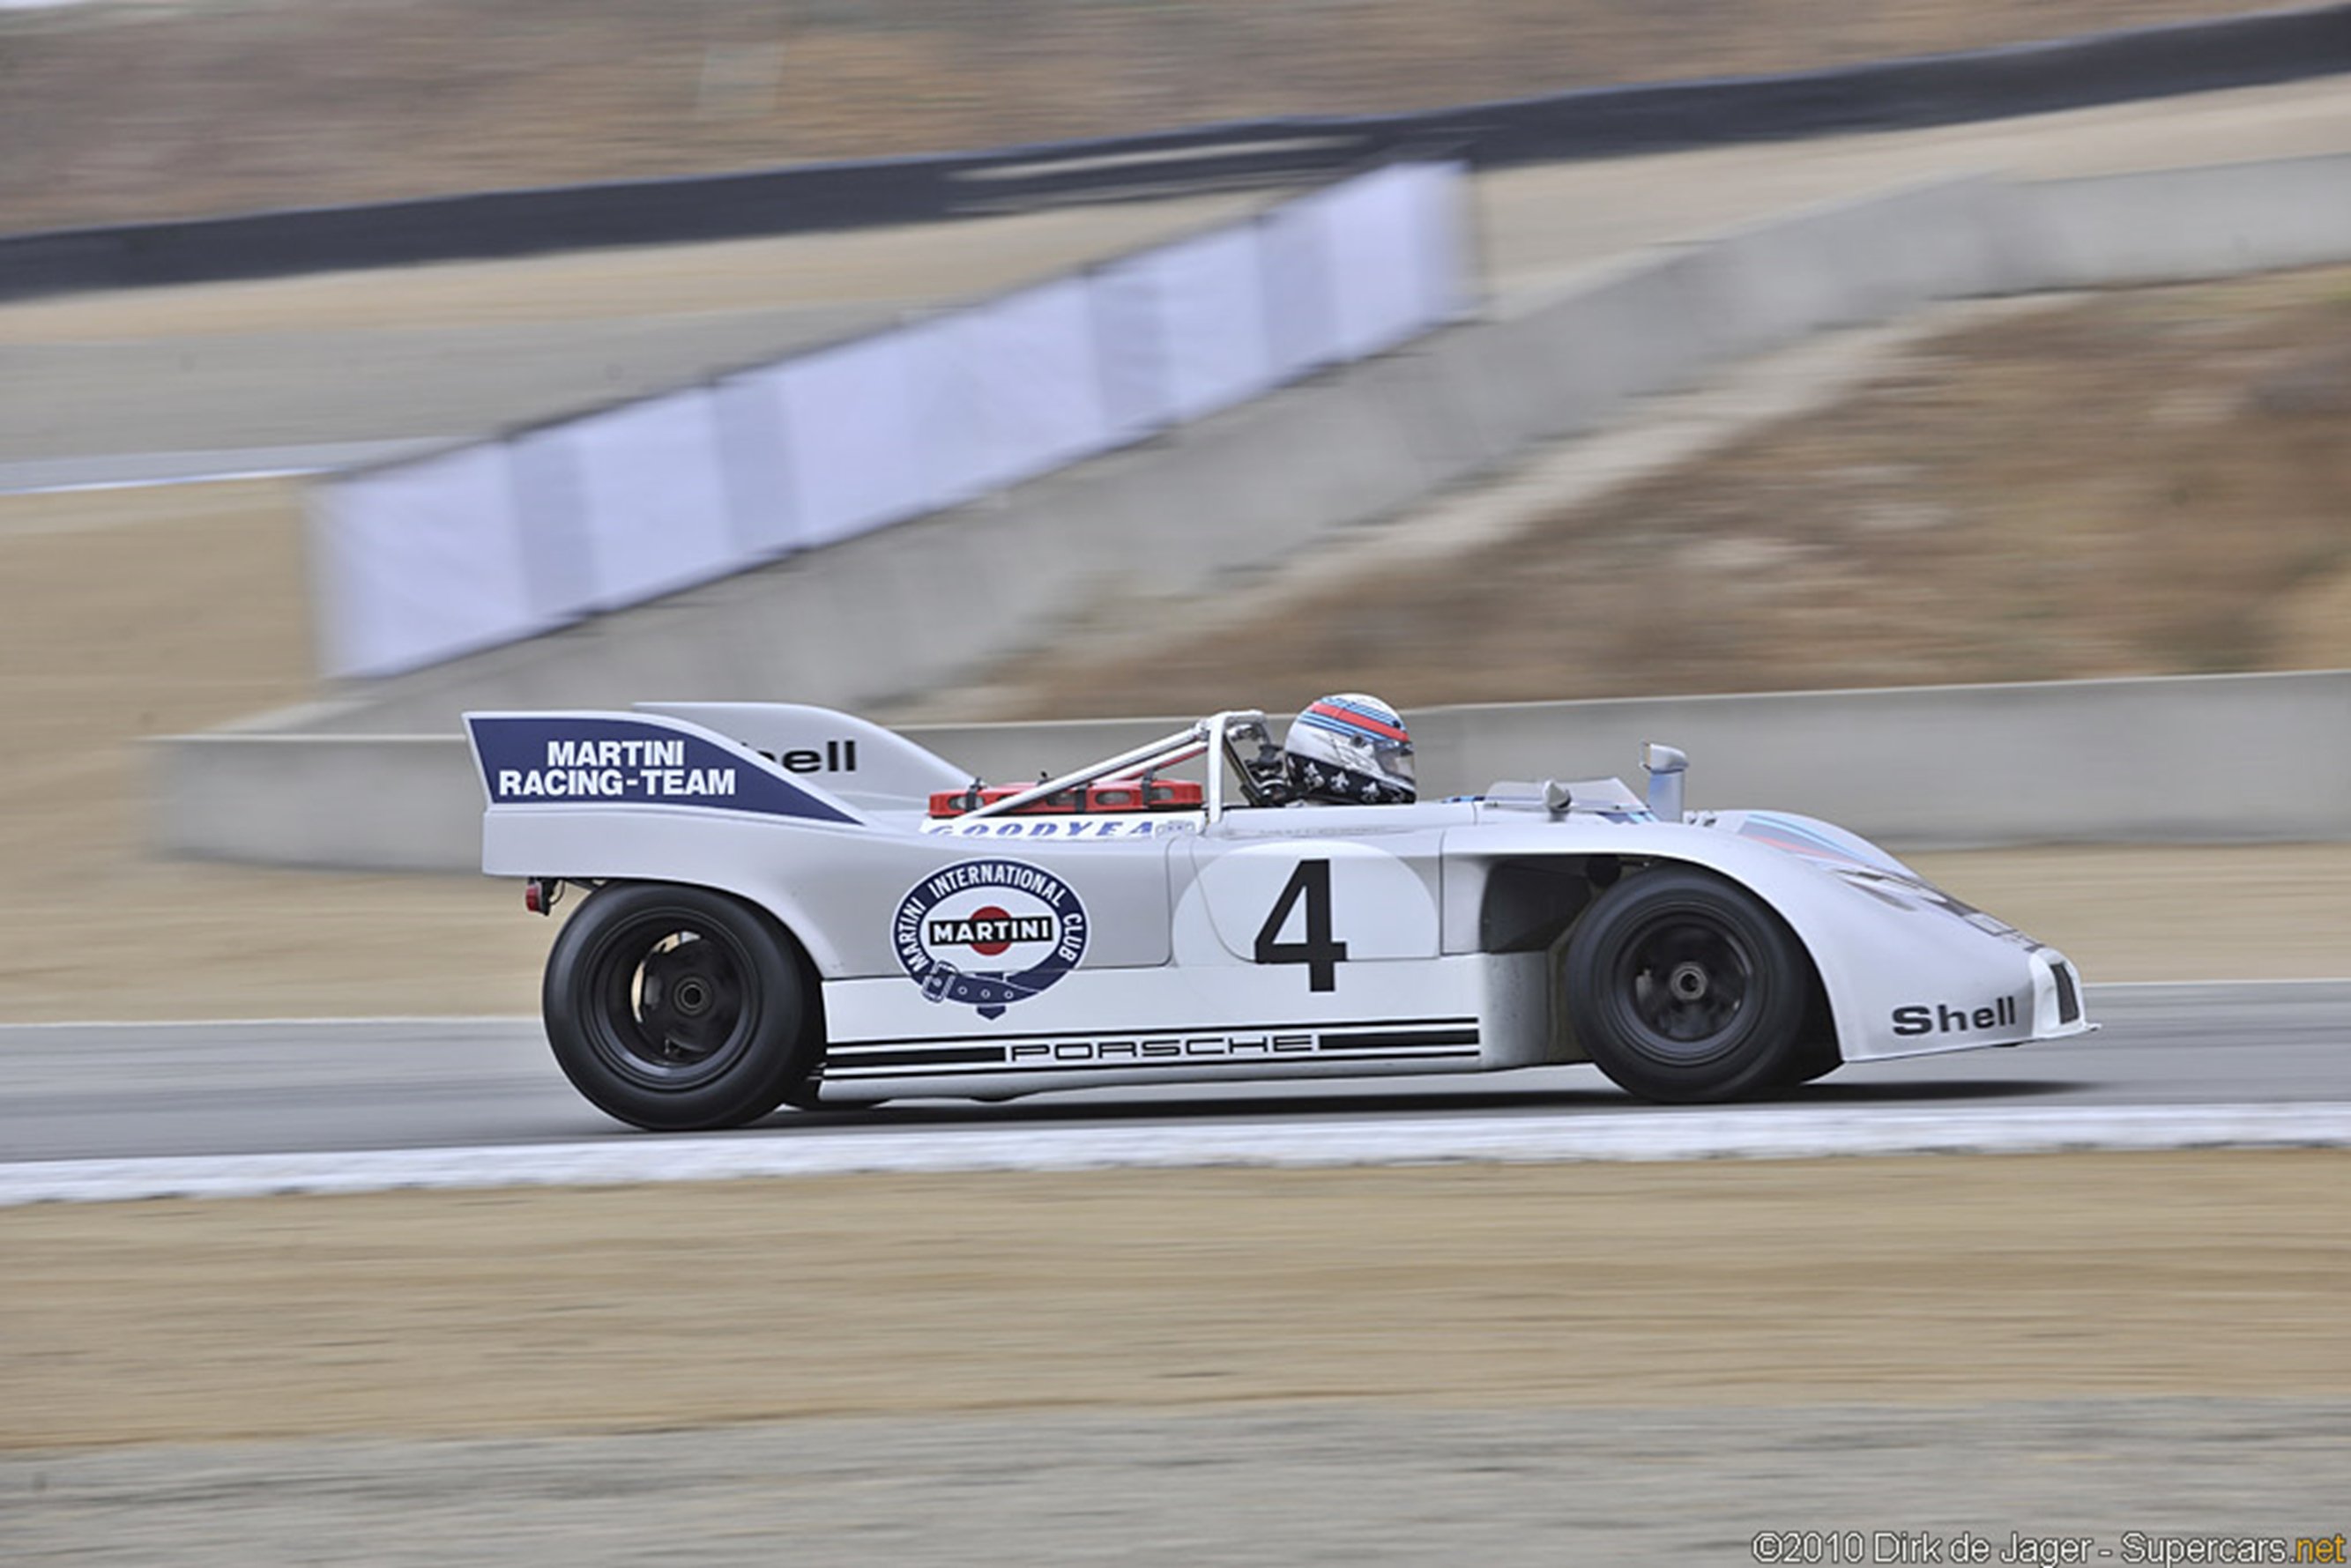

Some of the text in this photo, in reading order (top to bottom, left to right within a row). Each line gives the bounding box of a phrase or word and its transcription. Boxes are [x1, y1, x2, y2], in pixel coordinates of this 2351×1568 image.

[547, 740, 684, 767] MARTINI
[740, 740, 856, 774] ell
[498, 769, 736, 796] RACING-TEAM
[928, 821, 1154, 836] GOODYEA
[897, 864, 1083, 971] MARTINI INTERNATIONAL CLUB
[933, 919, 1050, 943] MARTINI
[1254, 858, 1348, 992] 4
[1892, 995, 2016, 1037] Shell
[1010, 1034, 1313, 1062] PORSCHE
